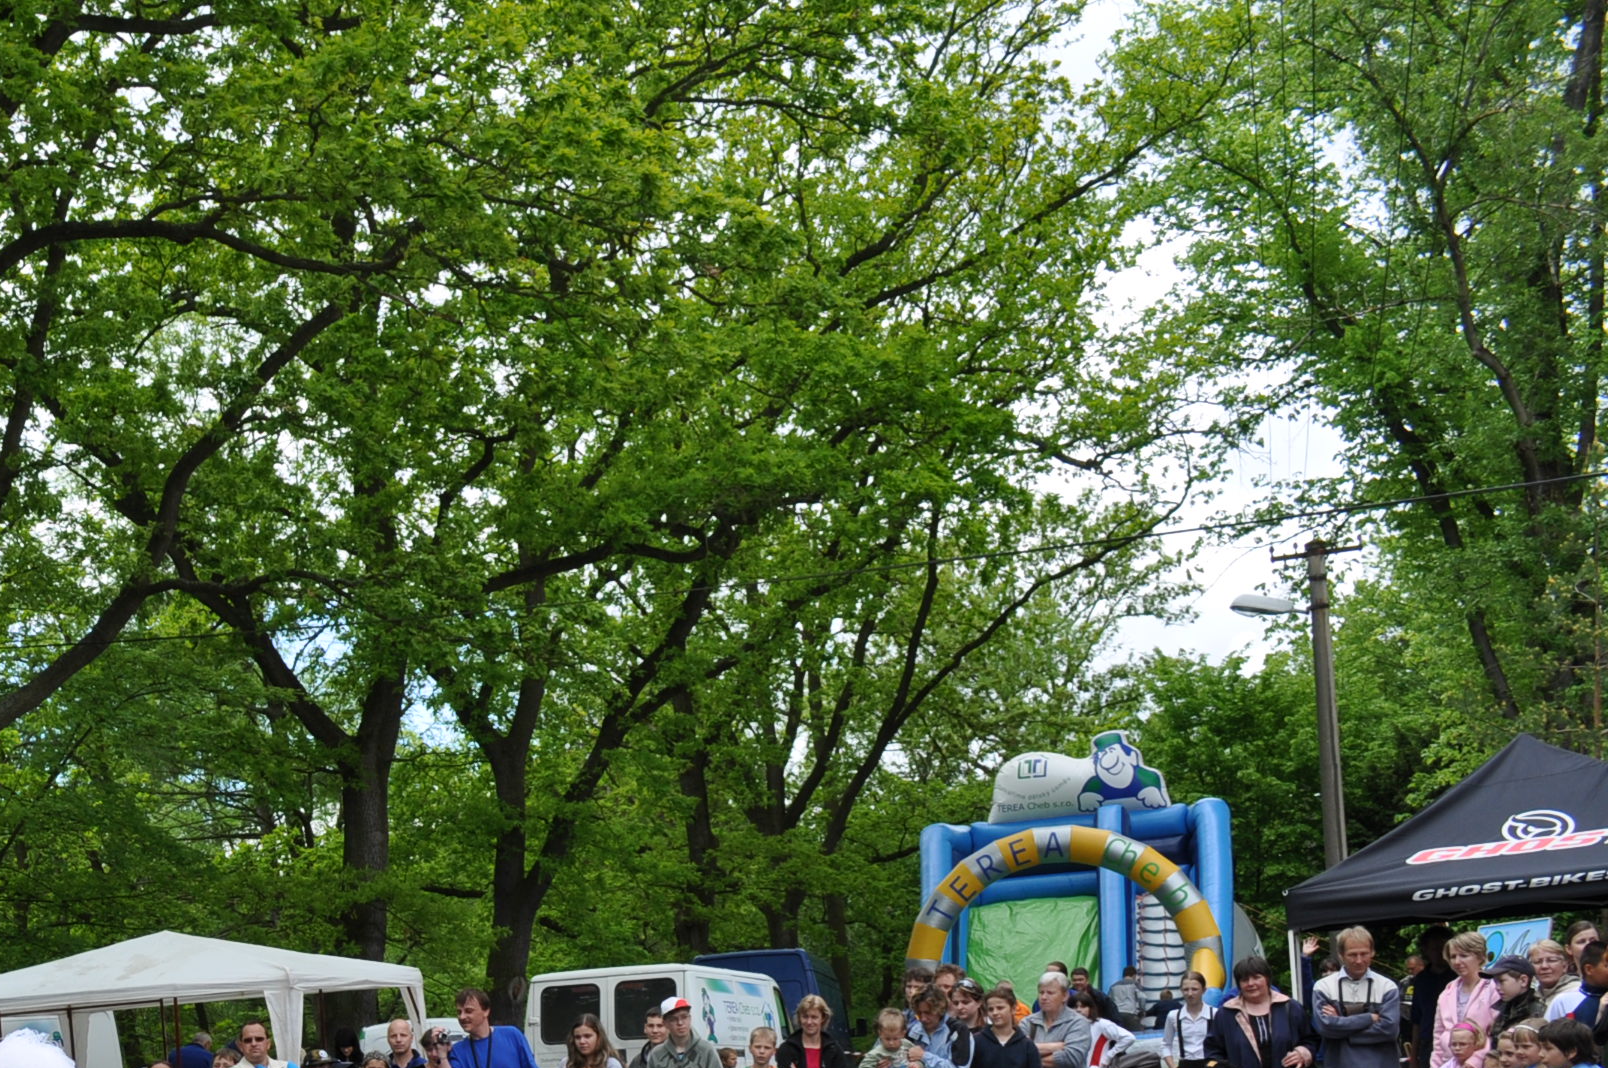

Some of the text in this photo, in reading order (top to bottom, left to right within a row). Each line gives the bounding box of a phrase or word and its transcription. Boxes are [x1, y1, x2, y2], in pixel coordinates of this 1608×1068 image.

[997, 803, 1025, 813] TEREA
[1026, 801, 1051, 810] Cheb
[1406, 829, 1608, 865] GHOS
[926, 831, 1190, 921] TEREA Cheb
[1412, 869, 1608, 901] GHOST-BIKE
